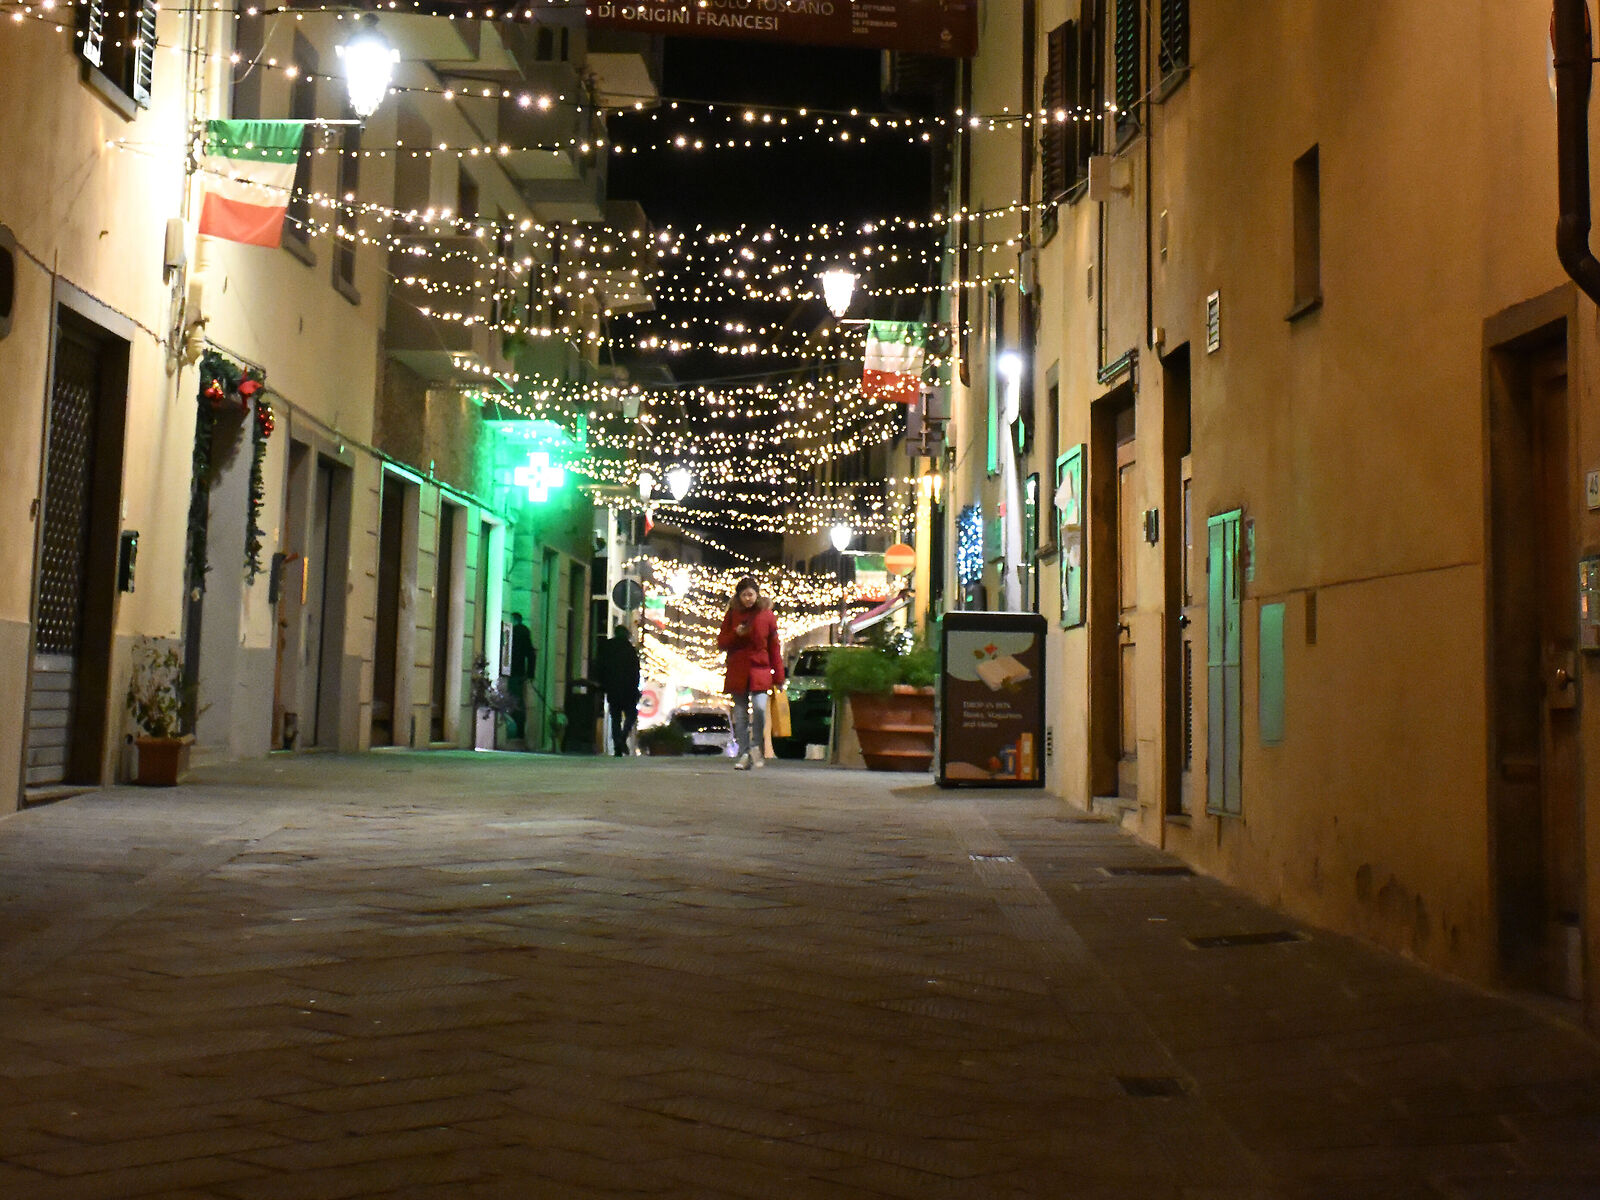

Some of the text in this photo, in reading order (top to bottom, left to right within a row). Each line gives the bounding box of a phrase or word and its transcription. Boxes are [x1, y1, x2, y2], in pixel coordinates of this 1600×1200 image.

[598, 4, 780, 32] DI ORIGINI FRANCESI
